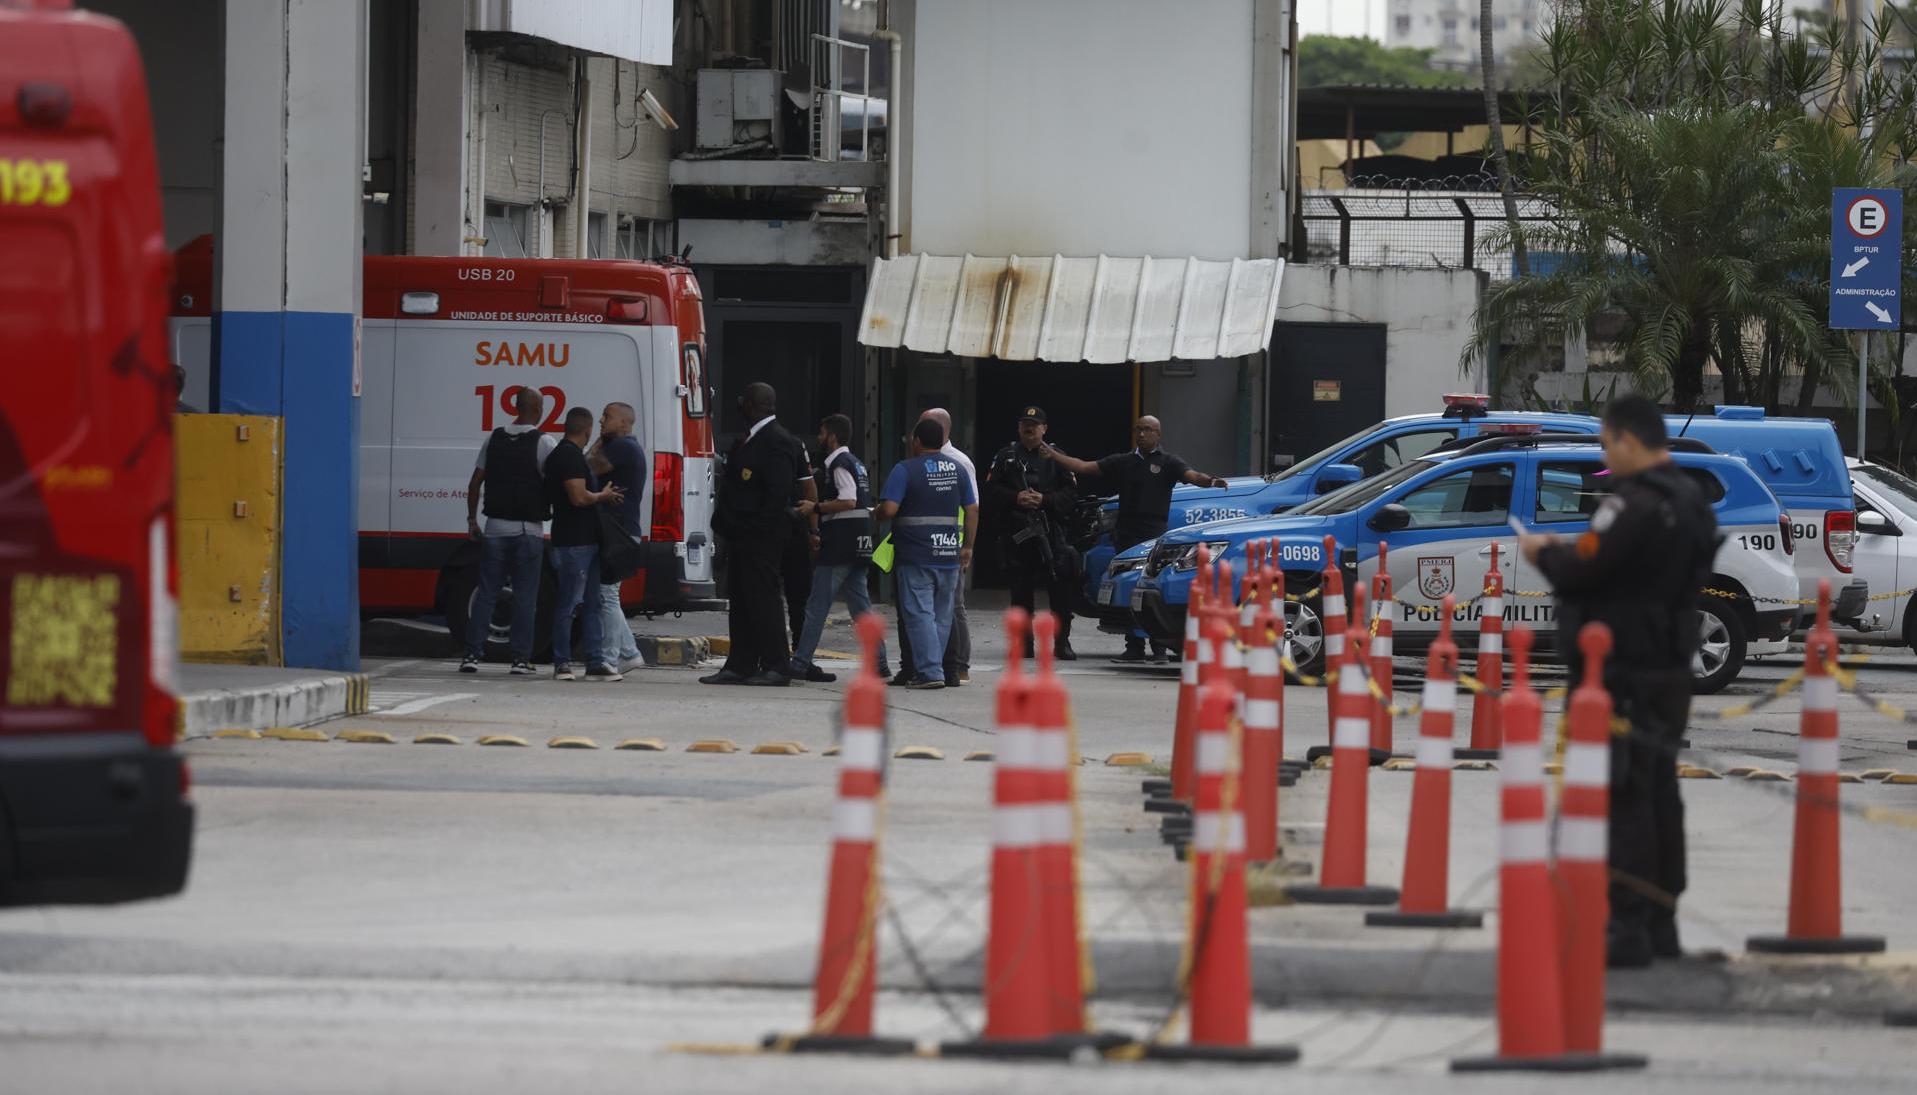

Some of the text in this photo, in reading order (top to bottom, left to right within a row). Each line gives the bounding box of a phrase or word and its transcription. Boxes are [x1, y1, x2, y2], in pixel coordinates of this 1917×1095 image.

[0, 158, 70, 206] 193
[1859, 207, 1876, 229] E
[1854, 245, 1879, 253] BPTUR
[458, 268, 515, 281] USB 20
[1835, 288, 1896, 297] ADMINISTRAÇÃO
[451, 311, 604, 323] UNIDADE DE SUPORTE BÁSICO
[475, 341, 569, 367] SAMU
[938, 460, 956, 472] Rio
[399, 488, 434, 500] Serviço
[436, 488, 448, 498] de
[1793, 523, 1817, 539] 90
[930, 533, 957, 546] 1746
[1738, 534, 1775, 550] 190
[1404, 605, 1483, 621] POLCIA
